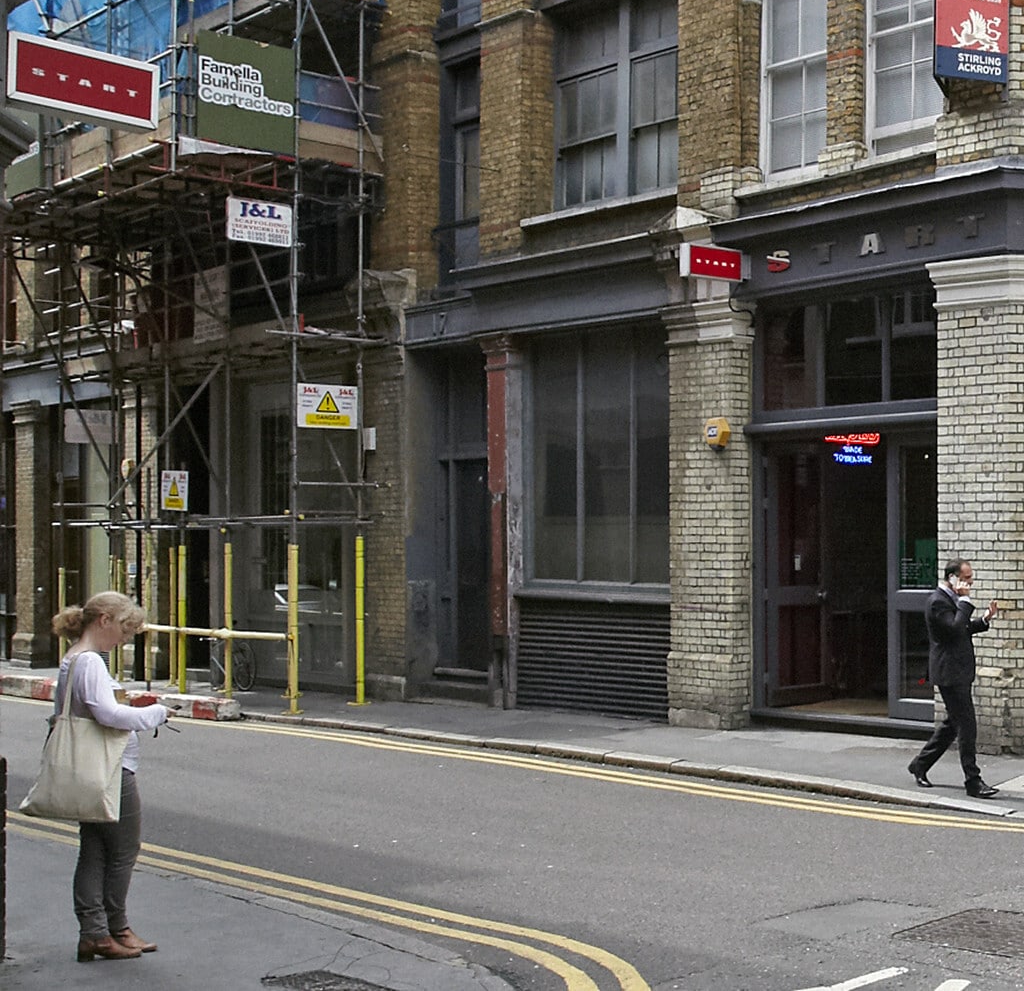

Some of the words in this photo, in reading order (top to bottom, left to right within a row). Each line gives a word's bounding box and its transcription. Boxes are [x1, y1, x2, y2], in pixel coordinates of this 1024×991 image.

[201, 58, 260, 82] Famella
[957, 52, 1001, 66] STIRLING
[957, 63, 1001, 76] ACKROYD
[32, 67, 138, 98] START
[201, 72, 263, 98] Building
[200, 86, 292, 115] Contractors
[766, 213, 985, 273] START
